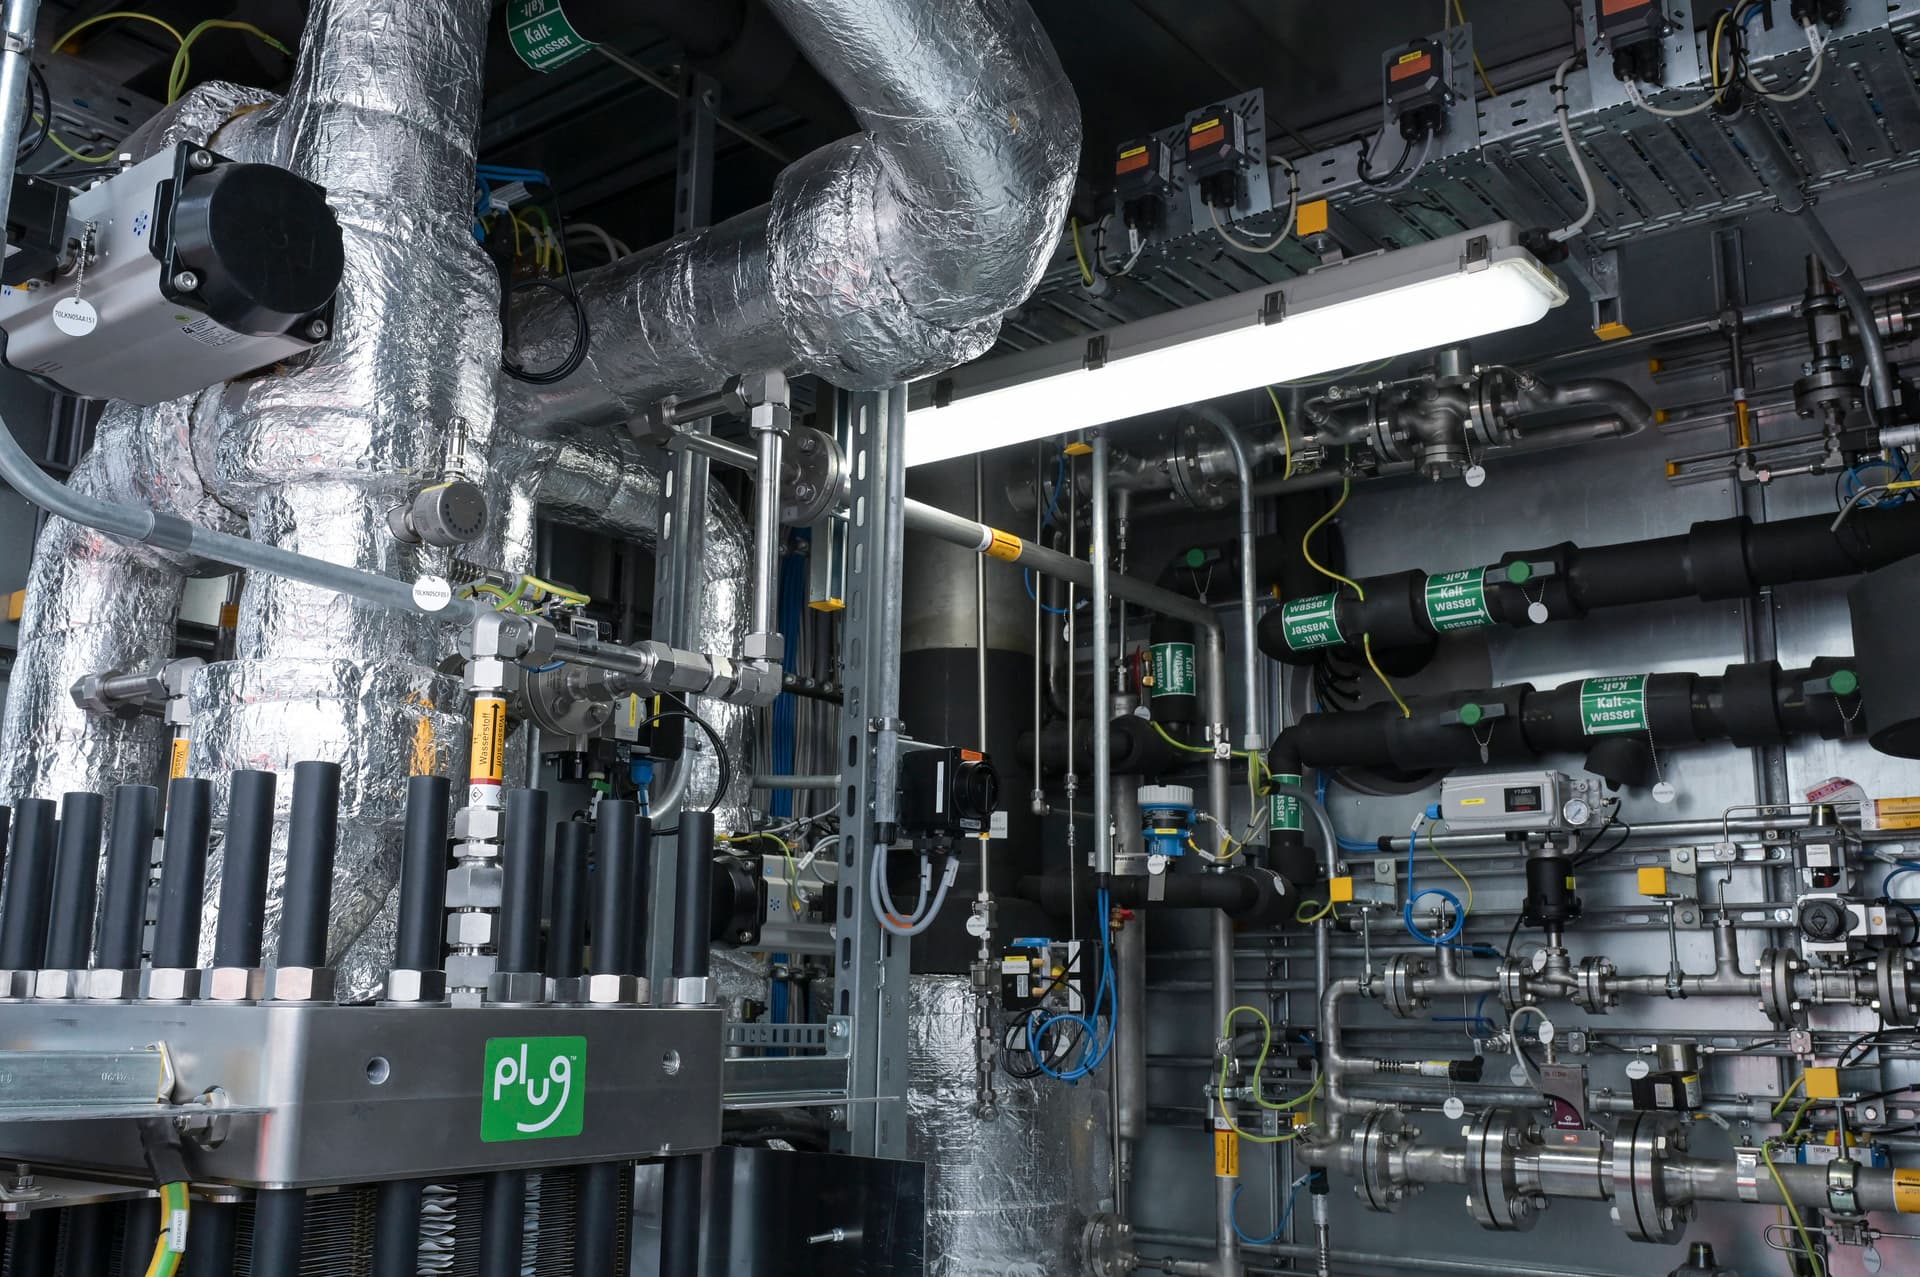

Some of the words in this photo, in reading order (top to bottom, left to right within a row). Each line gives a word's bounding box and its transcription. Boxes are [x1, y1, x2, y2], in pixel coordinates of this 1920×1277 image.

[524, 24, 552, 44] Kalt-
[528, 35, 572, 59] wasser
[1440, 585, 1467, 599] Kalt-
[1290, 600, 1328, 613] wasser
[1434, 598, 1477, 612] wasser
[1291, 621, 1329, 635] wasser
[1302, 633, 1328, 644] Kalt-
[1175, 650, 1184, 687] wasser
[1598, 682, 1628, 691] Kalt-
[1597, 696, 1627, 709] Kalt-
[1590, 709, 1636, 722] wasser
[480, 713, 490, 765] Wasserstoff
[1287, 796, 1298, 815] alt-
[493, 1043, 571, 1132] plug
